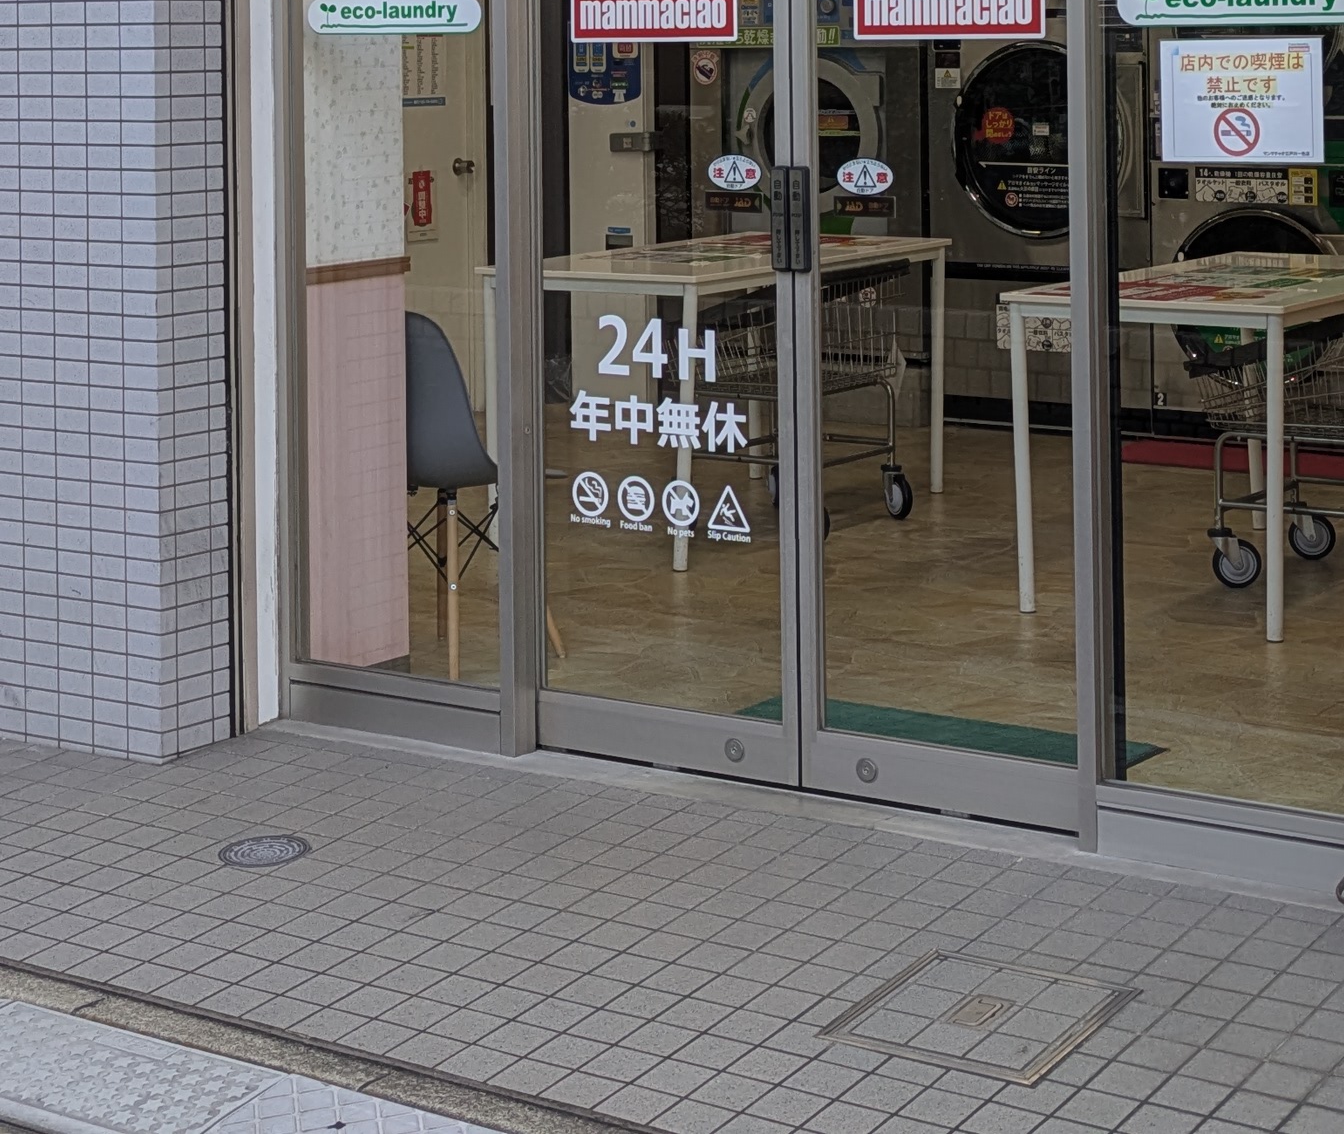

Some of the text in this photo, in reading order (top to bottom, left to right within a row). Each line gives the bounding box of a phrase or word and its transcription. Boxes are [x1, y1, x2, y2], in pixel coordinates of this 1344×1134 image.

[340, 0, 458, 23] eco-laundry
[1180, 53, 1304, 72] 店内での喫煙は
[1207, 76, 1276, 94] 禁止です
[713, 168, 757, 179] 注意
[843, 172, 888, 183] 注意
[597, 314, 716, 383] 24H
[1157, 393, 1164, 406] 2
[569, 390, 748, 454] 年中無休
[570, 514, 611, 528] No smoking
[620, 520, 652, 532] Food ban
[667, 526, 695, 538] No pets
[707, 530, 751, 543] Slip Caution
